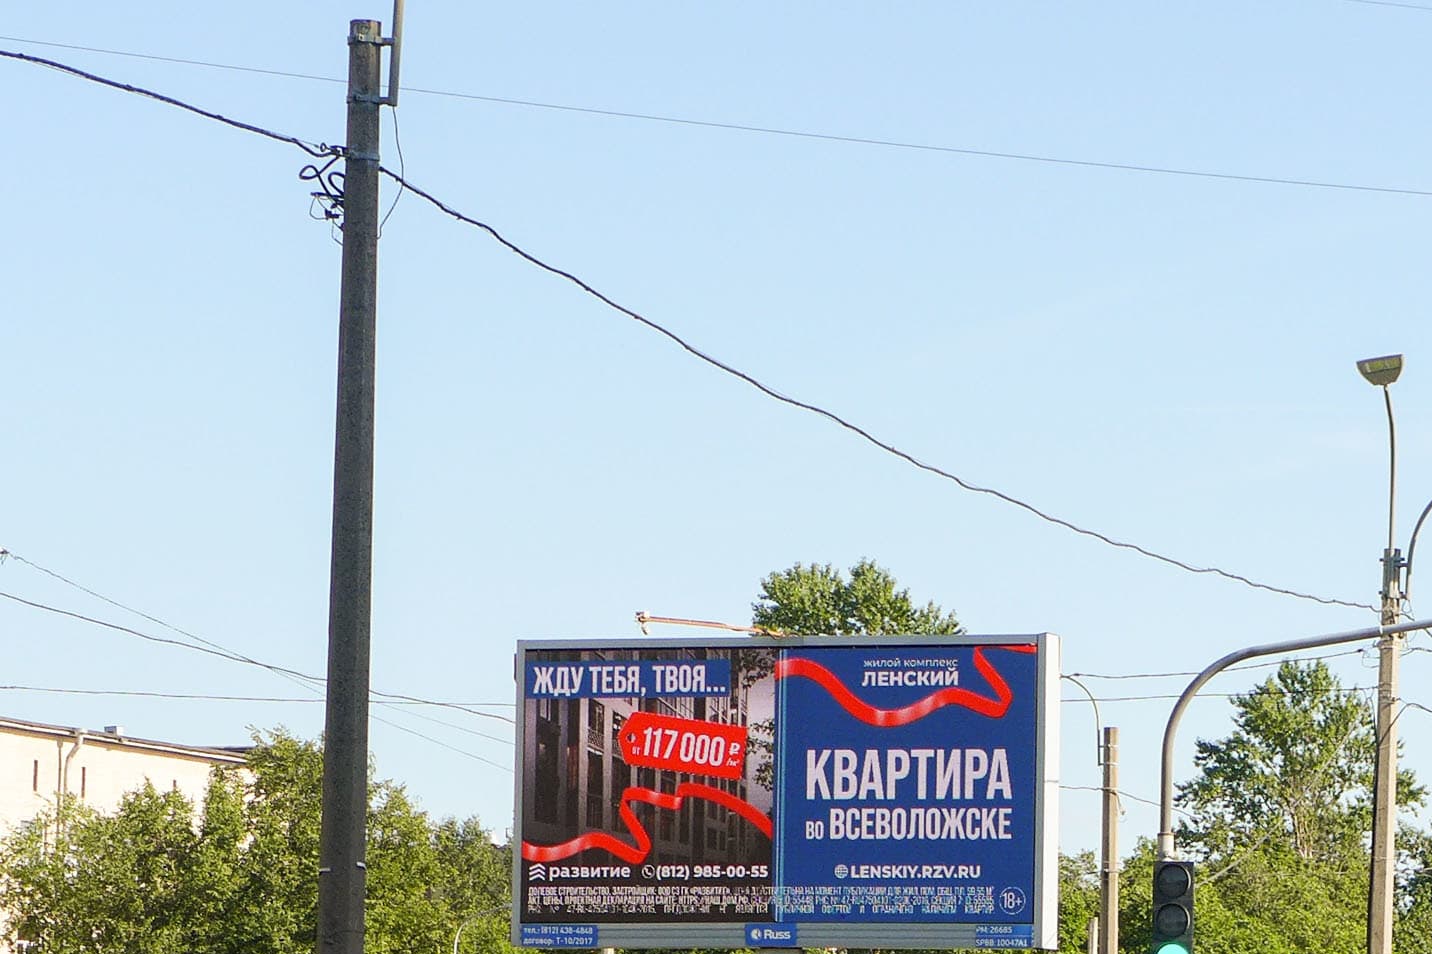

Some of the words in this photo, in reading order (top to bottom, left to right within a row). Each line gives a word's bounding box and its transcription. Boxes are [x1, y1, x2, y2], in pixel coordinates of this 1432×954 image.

[863, 657, 901, 668] жилой
[903, 658, 959, 668] комплекс
[533, 666, 584, 696] ЖДУ
[589, 665, 647, 696] ТЕБЯ,
[652, 664, 726, 693] ТВОЯ...
[861, 667, 959, 687] ЛЕНСКИЙ
[643, 726, 679, 759] 117
[680, 732, 726, 767] 000
[805, 748, 1013, 800] КВАРТИРА
[829, 807, 1013, 840] ВСЕВОЛОЖСКЕ
[549, 865, 631, 881] развитие
[656, 864, 690, 881] (812)
[693, 864, 769, 879] 985-00-55
[850, 865, 981, 880] LENSKIY.RZV.RU
[1001, 892, 1023, 909] 18+
[763, 929, 791, 939] Russ
